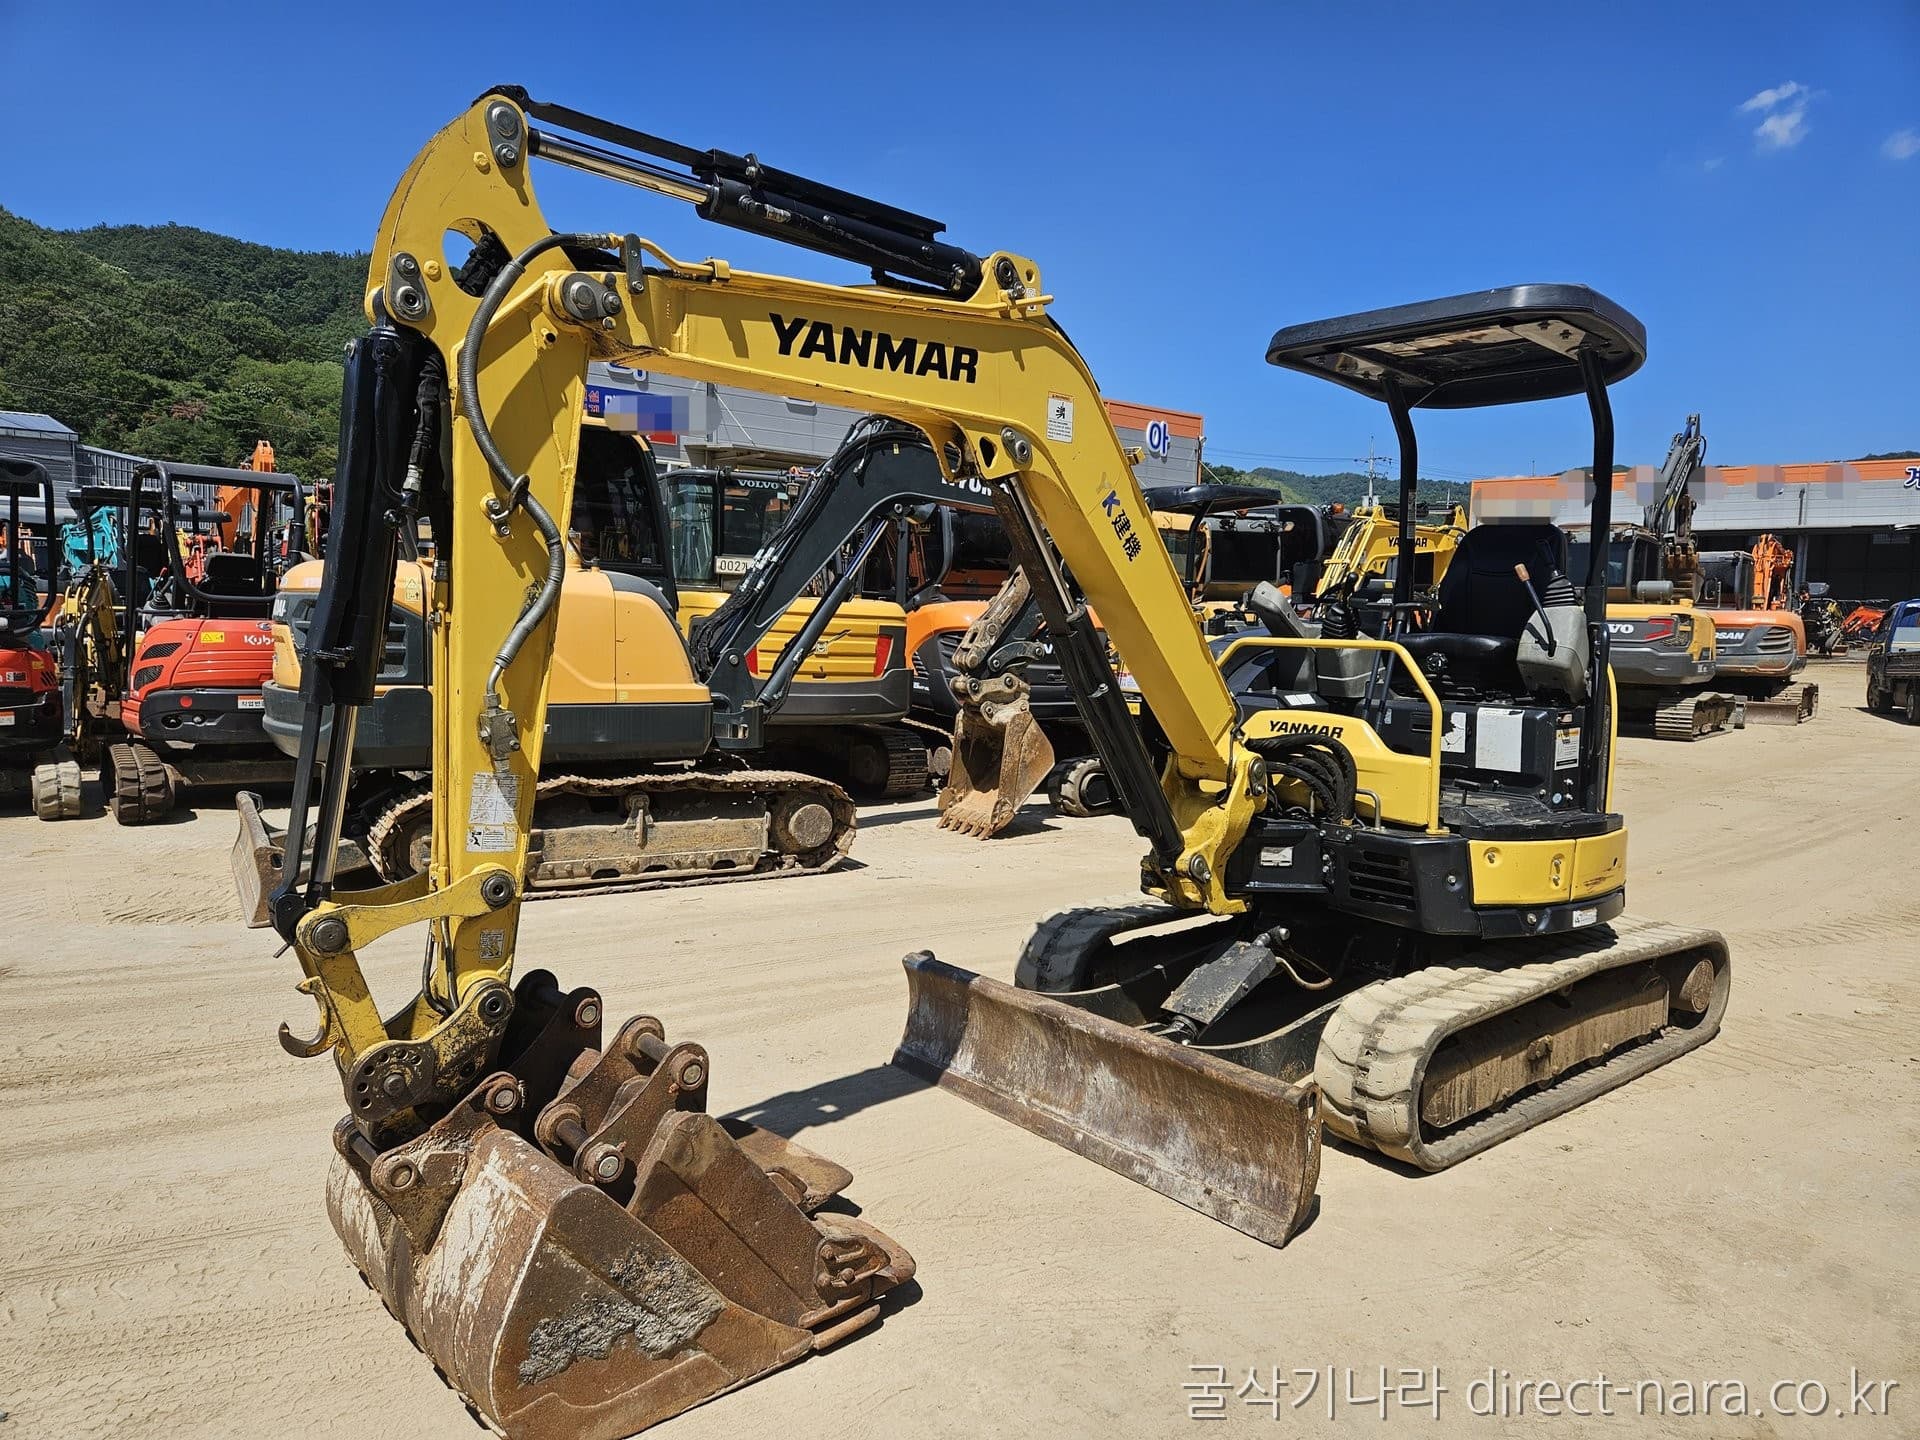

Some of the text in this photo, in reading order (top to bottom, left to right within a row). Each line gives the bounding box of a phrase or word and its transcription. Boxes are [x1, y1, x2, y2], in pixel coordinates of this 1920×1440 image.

[769, 312, 979, 384] YANMAR
[1147, 421, 1170, 457] 아
[737, 479, 779, 489] VOLVO
[1269, 720, 1344, 738] YANMAR
